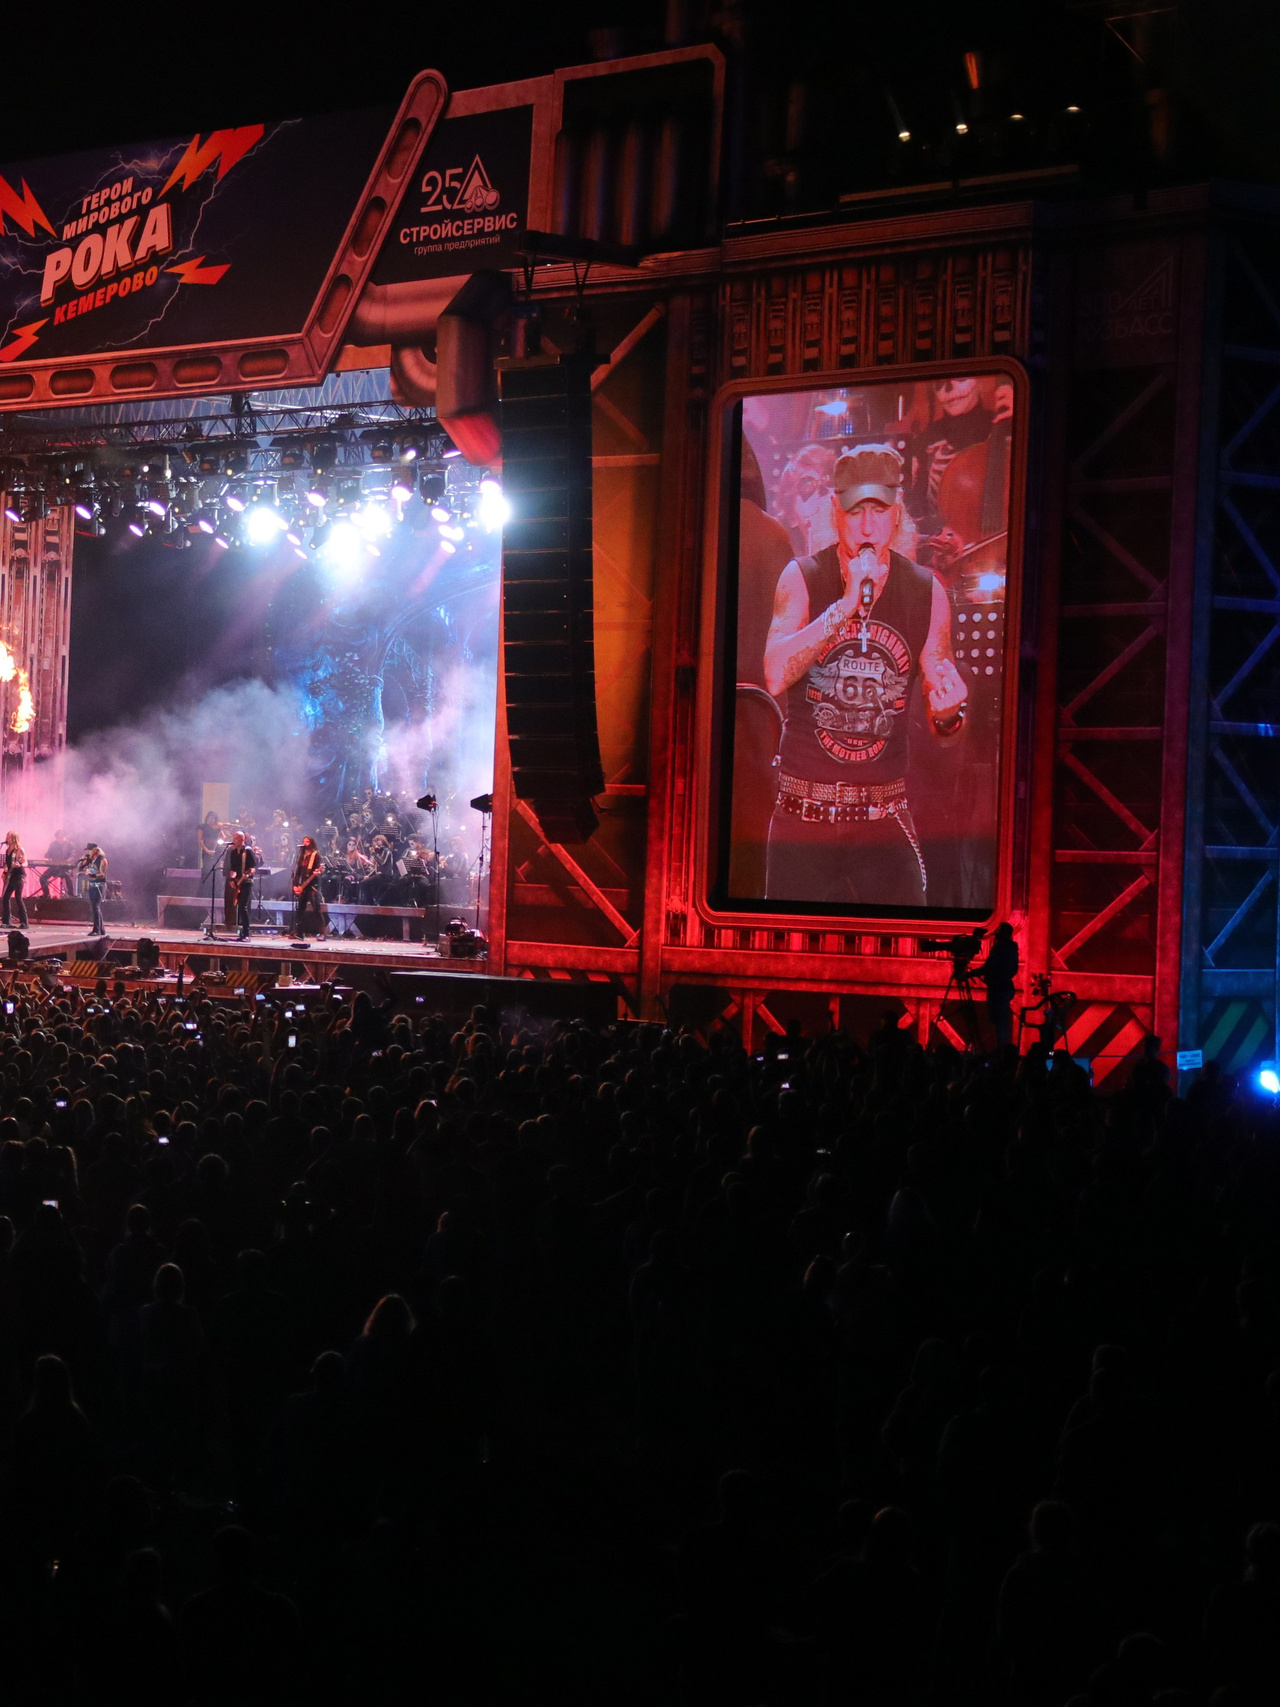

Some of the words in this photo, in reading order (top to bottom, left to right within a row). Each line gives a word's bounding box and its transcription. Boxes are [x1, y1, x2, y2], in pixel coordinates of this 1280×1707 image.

[81, 176, 134, 214] ГЕРОИ
[62, 186, 153, 241] МИРОВОГО
[400, 212, 518, 244] СТРОЙСЕРВИС
[40, 202, 172, 307] РОКА
[414, 243, 443, 256] группа
[444, 234, 501, 252] предприятий
[53, 265, 159, 326] КЕМЕРОВО
[843, 658, 880, 672] ROUTE
[842, 675, 877, 701] 66
[831, 744, 867, 761] MOTHER
